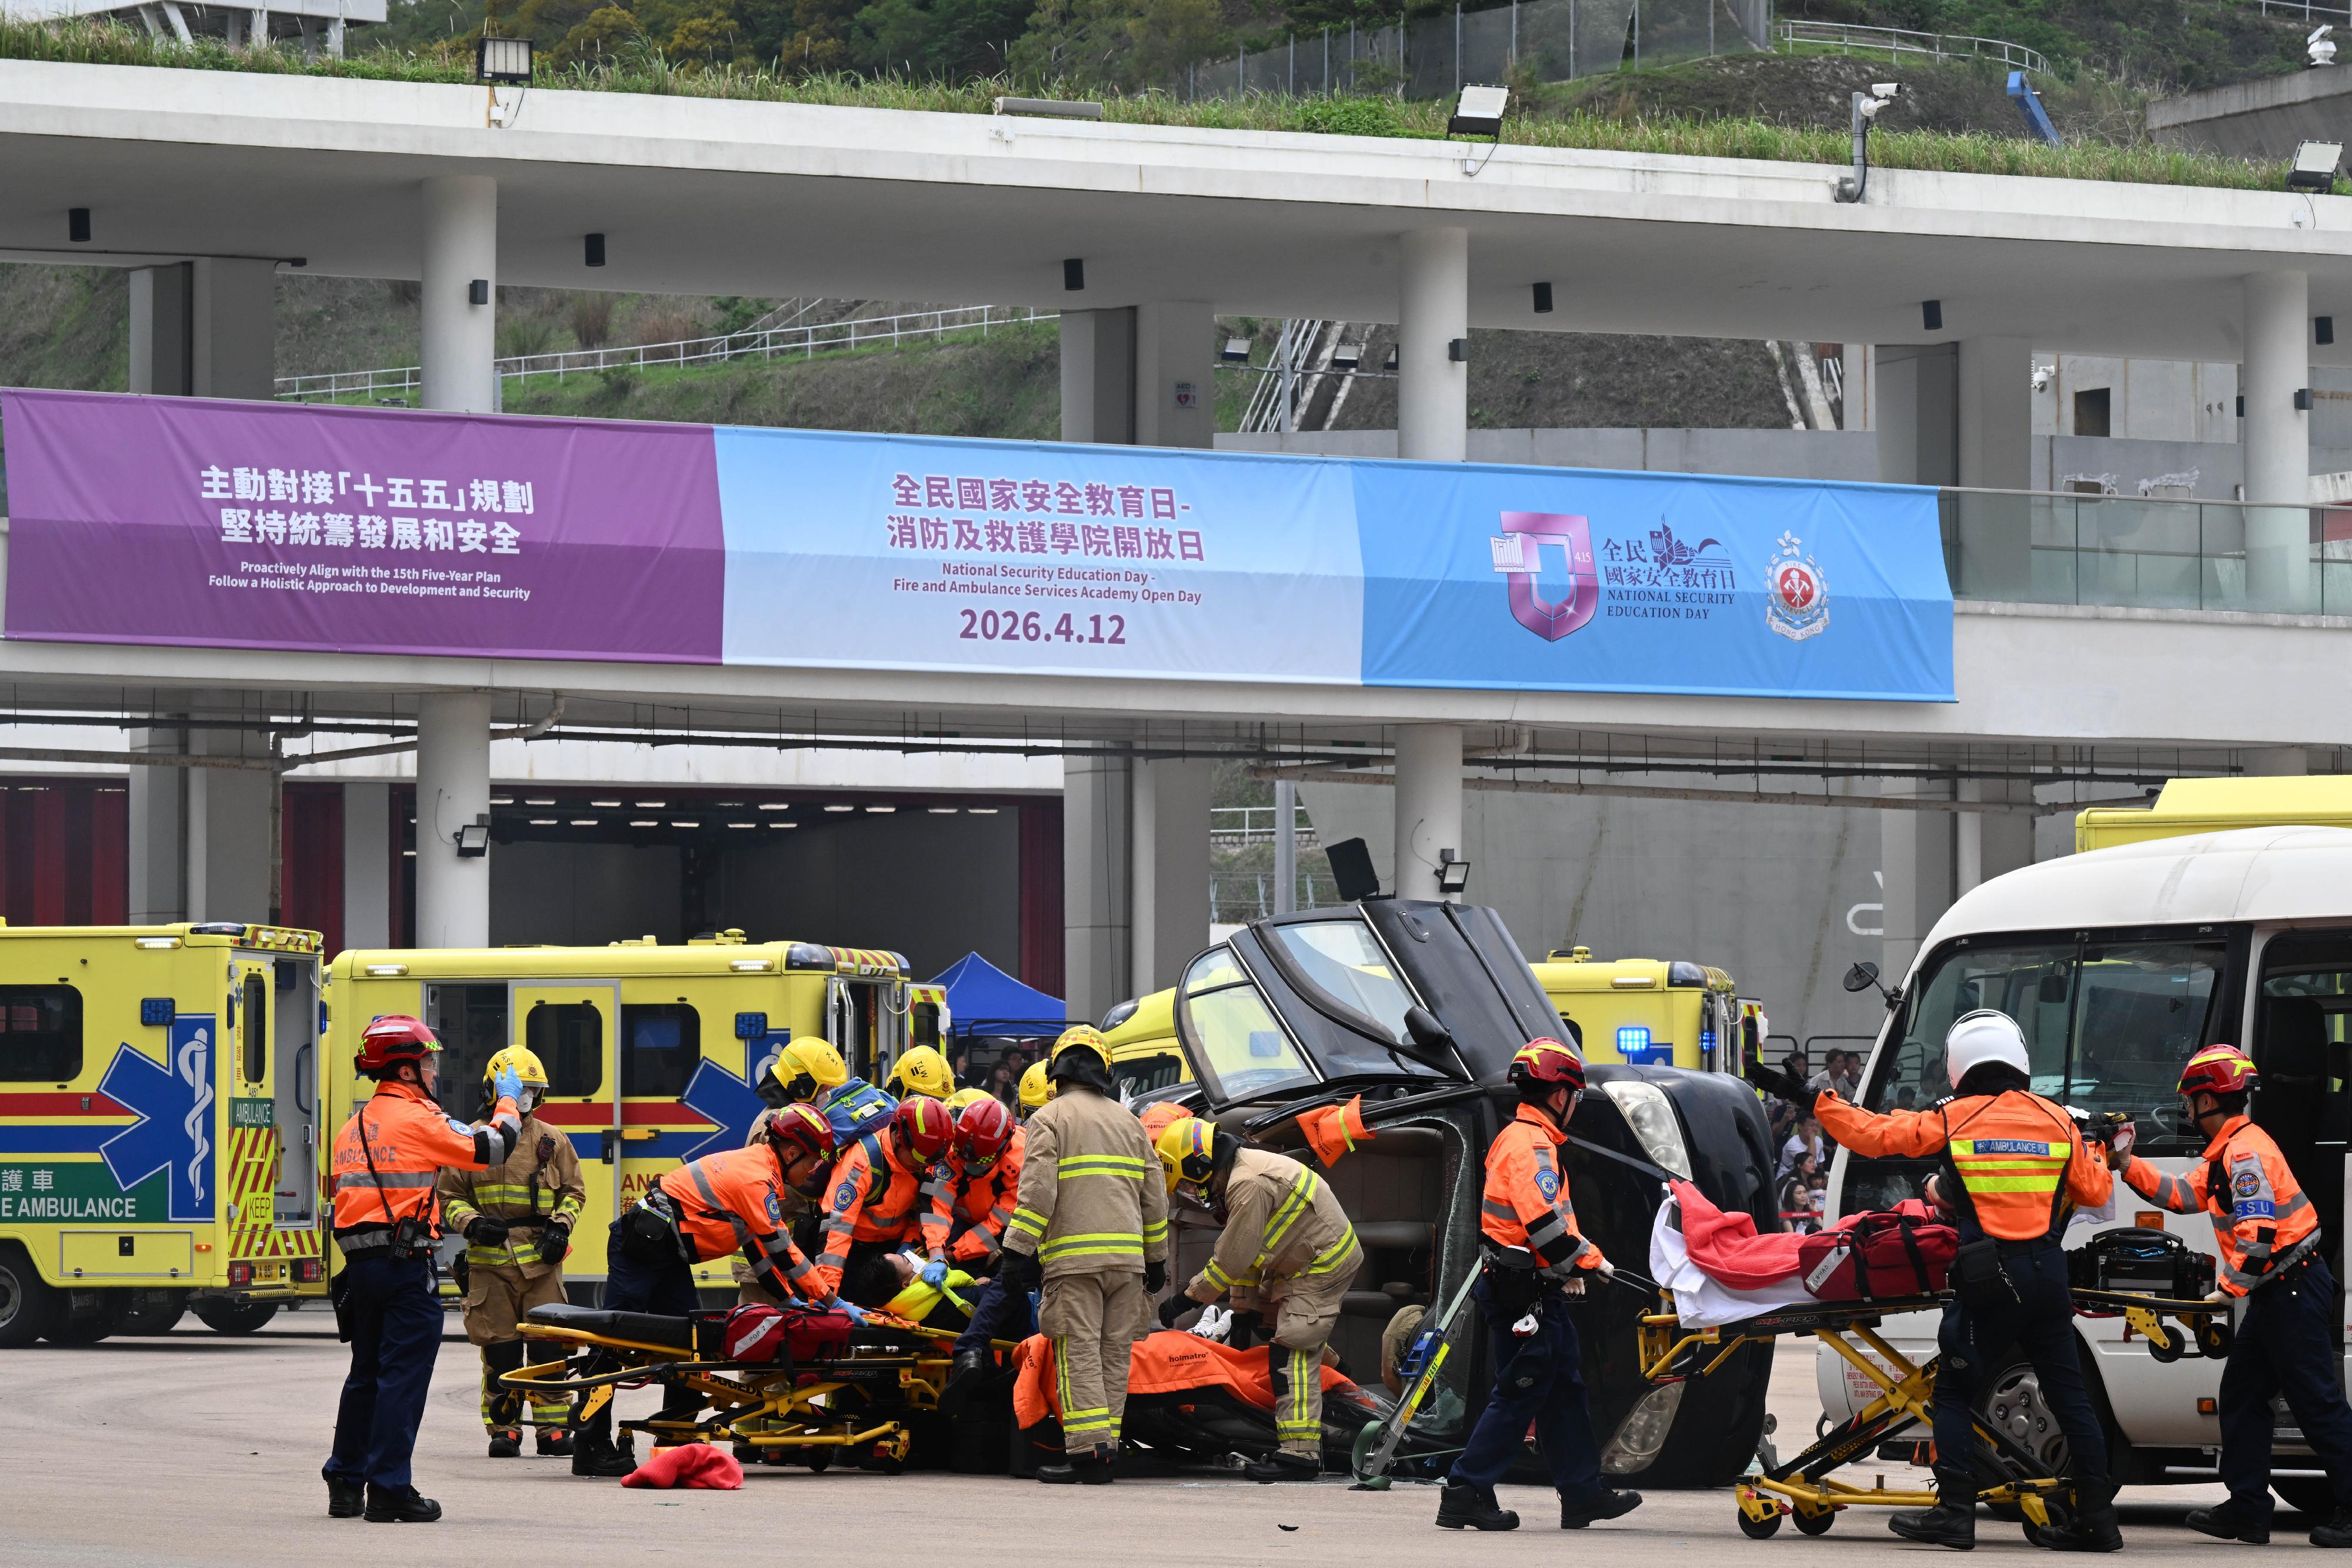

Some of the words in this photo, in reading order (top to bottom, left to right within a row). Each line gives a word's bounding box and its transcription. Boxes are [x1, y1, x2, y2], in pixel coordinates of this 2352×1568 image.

[201, 464, 534, 514] 主動對接「十五五」規劃
[891, 474, 1191, 520] 全民國家安全教育日-
[220, 508, 521, 554] 堅持統籌發展和安全
[886, 514, 1205, 562] 消防及救護學院開放日
[1575, 551, 1591, 563] 4.15
[1601, 537, 1648, 563] 全民
[241, 561, 307, 577] Proactively
[309, 564, 339, 579] Align
[342, 566, 368, 577] with
[371, 567, 390, 579] the
[393, 568, 419, 580] 15th
[422, 569, 473, 581] Five-Year
[476, 571, 500, 583] Plan
[943, 563, 997, 577] National
[1001, 565, 1054, 581] Security
[1058, 567, 1121, 582] Education
[1124, 570, 1148, 586] Day
[1603, 565, 1736, 590] 國家安全教育日
[209, 575, 248, 587] Follow
[251, 579, 258, 588] a
[260, 577, 304, 590] Holistic
[307, 580, 362, 593] Approach
[366, 582, 377, 593] to
[380, 583, 457, 597] Development
[459, 586, 480, 597] and
[483, 587, 530, 601] Security
[894, 579, 918, 591] Fire
[922, 580, 946, 593] and
[949, 581, 1021, 596] Ambulance
[1024, 584, 1078, 598] Services
[1080, 586, 1138, 603] Academy
[1142, 589, 1174, 604] Open
[1178, 590, 1201, 605] Day
[1607, 590, 1671, 603] NATIONAL
[1675, 591, 1736, 604] SECURITY
[1607, 606, 1681, 619] EDUCATION
[1685, 607, 1710, 620] DAY
[1782, 603, 1814, 616] SERVICES
[959, 609, 1126, 646] 2026.4.12
[1775, 624, 1796, 638] HONG
[1800, 624, 1820, 638] KONG
[248, 1087, 258, 1098] A851
[236, 1102, 270, 1124] AMBULANCE
[349, 1123, 380, 1144] 救護
[334, 1146, 396, 1166] AMBULNCE
[1977, 1142, 1987, 1152] 救
[1989, 1141, 2037, 1153] AMBULANCE
[18, 1197, 136, 1217] AMBULANCE
[249, 1197, 270, 1219] KEEP
[259, 1265, 262, 1278] A
[1168, 1353, 1206, 1363] holmatro
